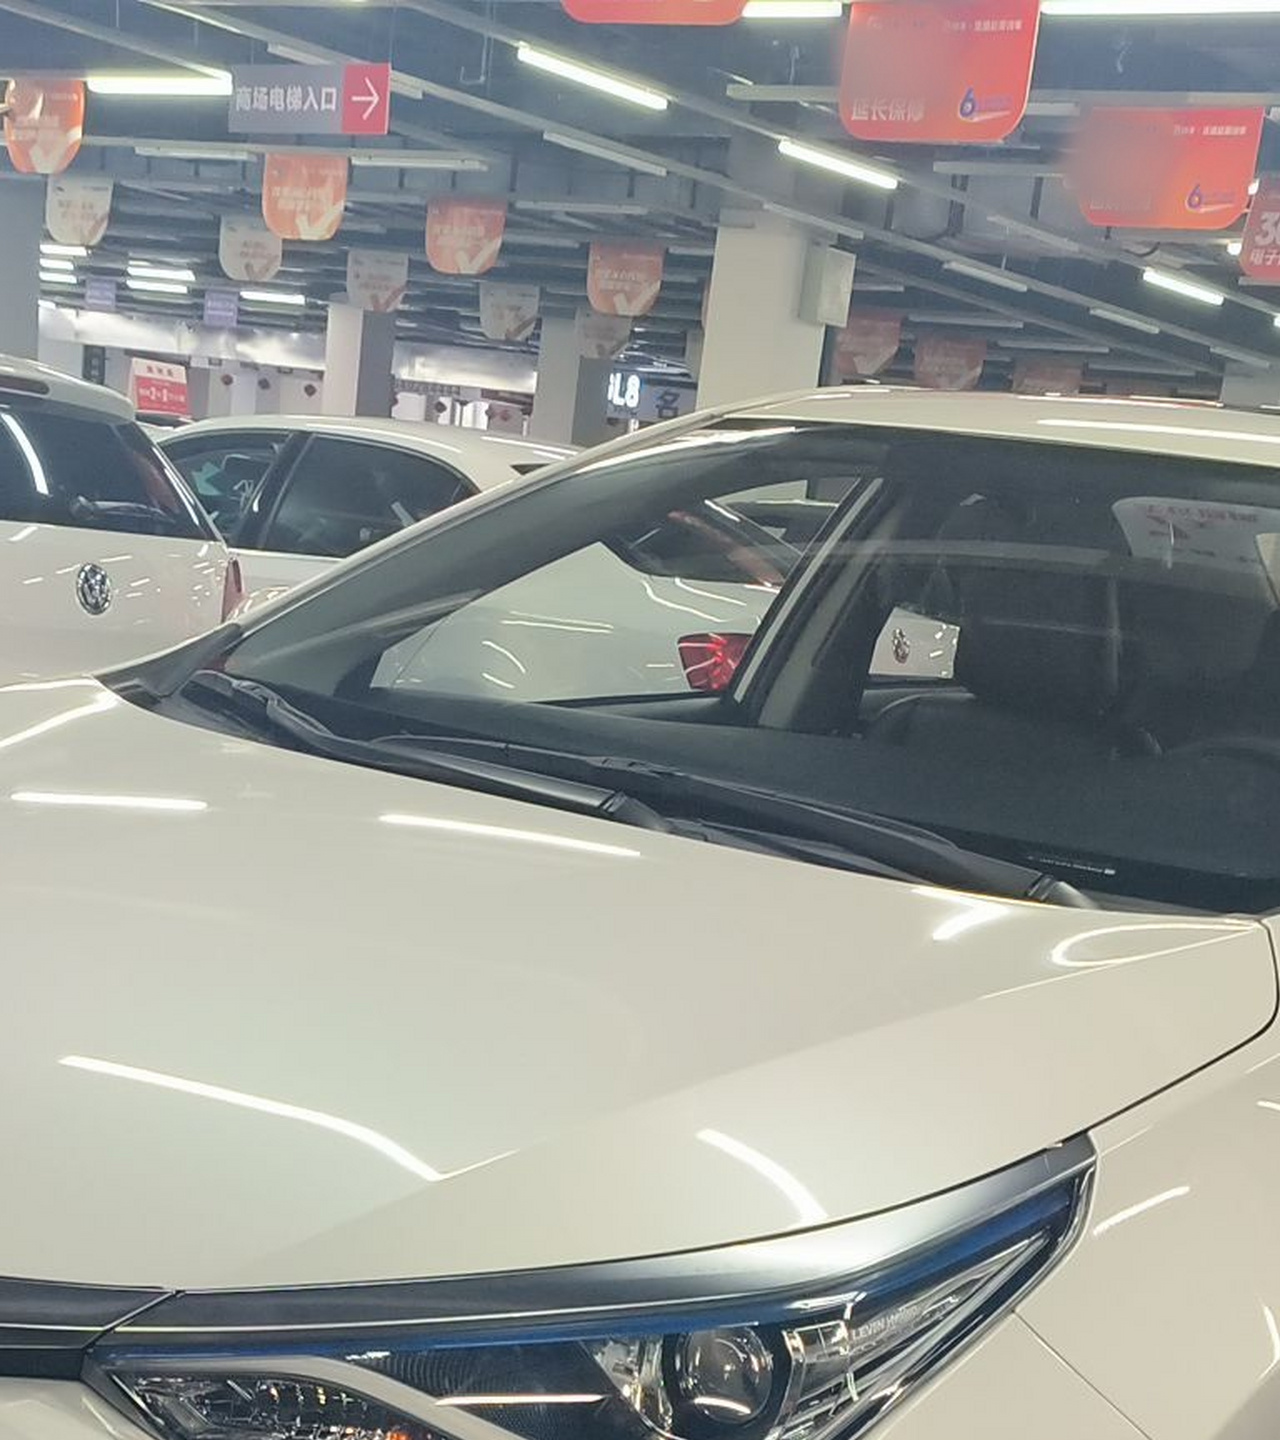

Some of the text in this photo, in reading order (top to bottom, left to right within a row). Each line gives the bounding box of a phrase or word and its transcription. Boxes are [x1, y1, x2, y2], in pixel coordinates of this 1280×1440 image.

[236, 86, 337, 111] 商场电梯入口
